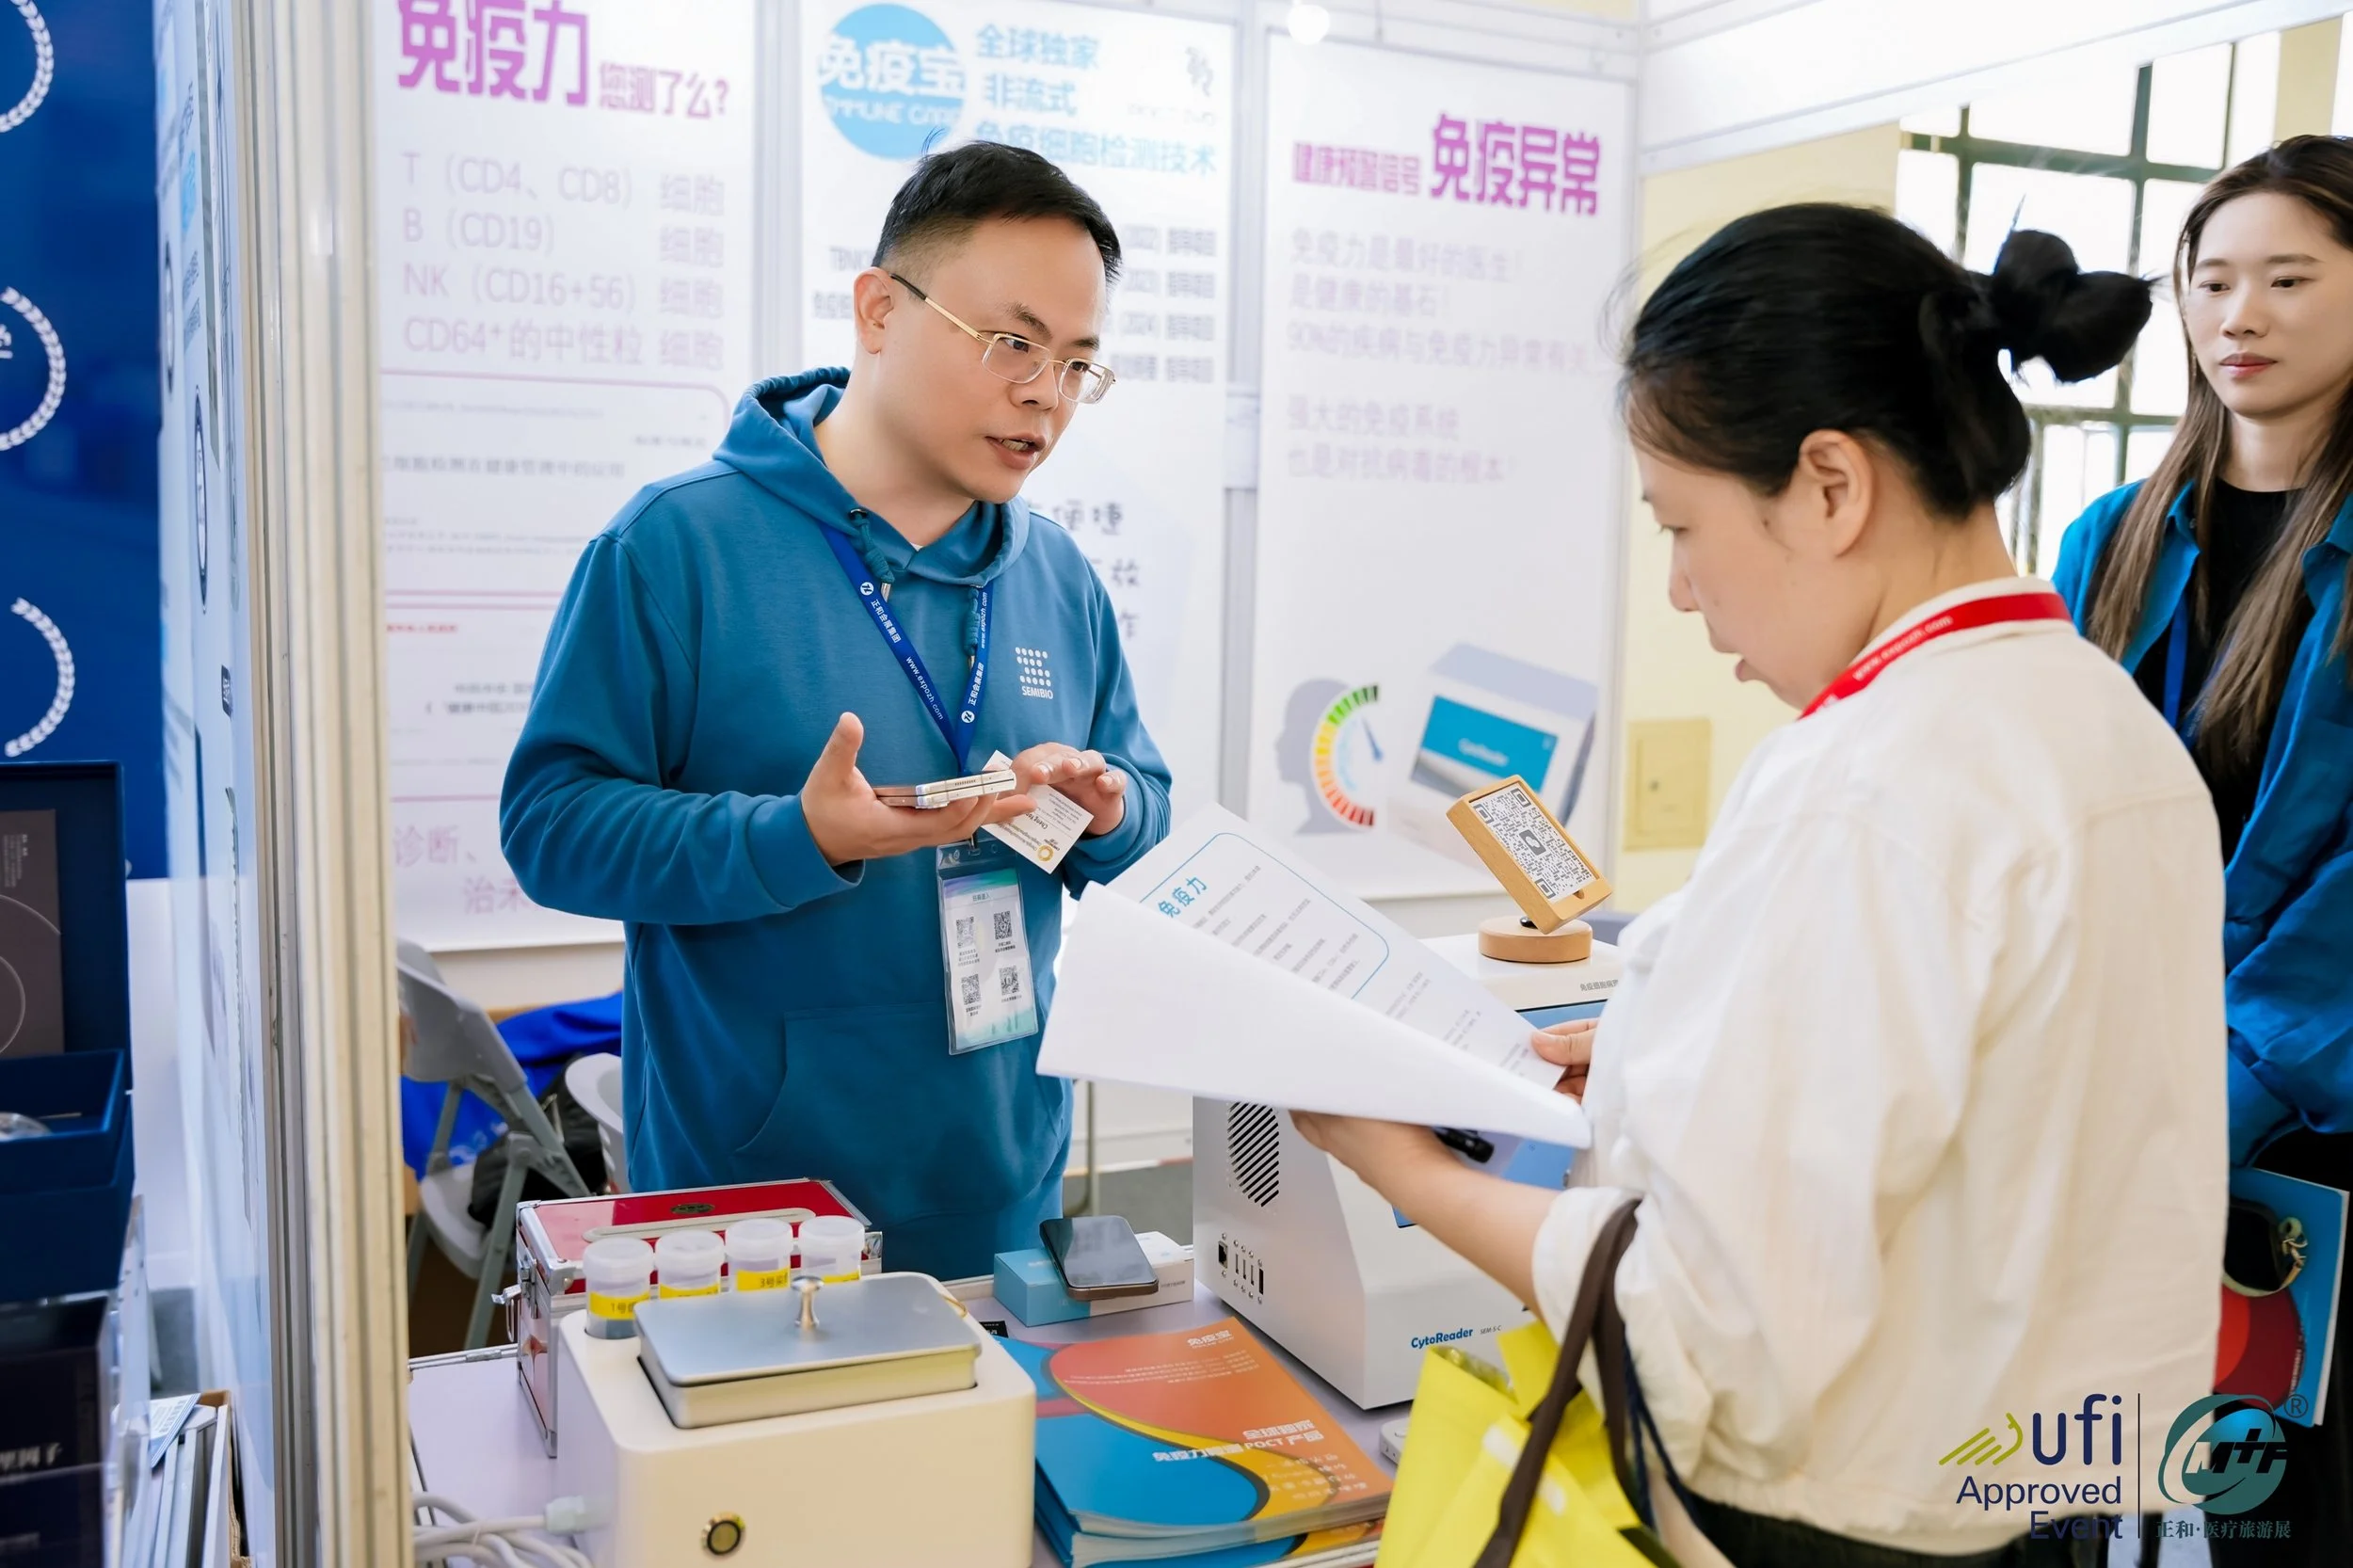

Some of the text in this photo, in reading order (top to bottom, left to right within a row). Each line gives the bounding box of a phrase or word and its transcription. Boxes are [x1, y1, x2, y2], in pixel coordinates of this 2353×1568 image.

[397, 0, 589, 105] 免疫力
[975, 22, 1100, 69] 全球独家
[984, 72, 1080, 117] 非流式
[1430, 112, 1600, 216] 免疫异常
[659, 173, 726, 216] 细胞
[402, 206, 424, 243] B
[659, 226, 726, 269] 细胞
[402, 263, 450, 298] NK
[659, 278, 726, 320] 细胞
[658, 329, 726, 371] 细胞
[871, 599, 902, 644] 正和会展集团
[905, 655, 944, 721] www.expozh.com
[1021, 685, 1054, 700] SEMIBIO
[1157, 875, 1209, 919] 免疫力
[1187, 1330, 1232, 1346] 免疫宝
[1411, 1327, 1474, 1351] CytoReader
[1242, 1419, 1316, 1440] 全球独家
[1244, 1437, 1285, 1450] POCT
[1286, 1430, 1324, 1446] 产品
